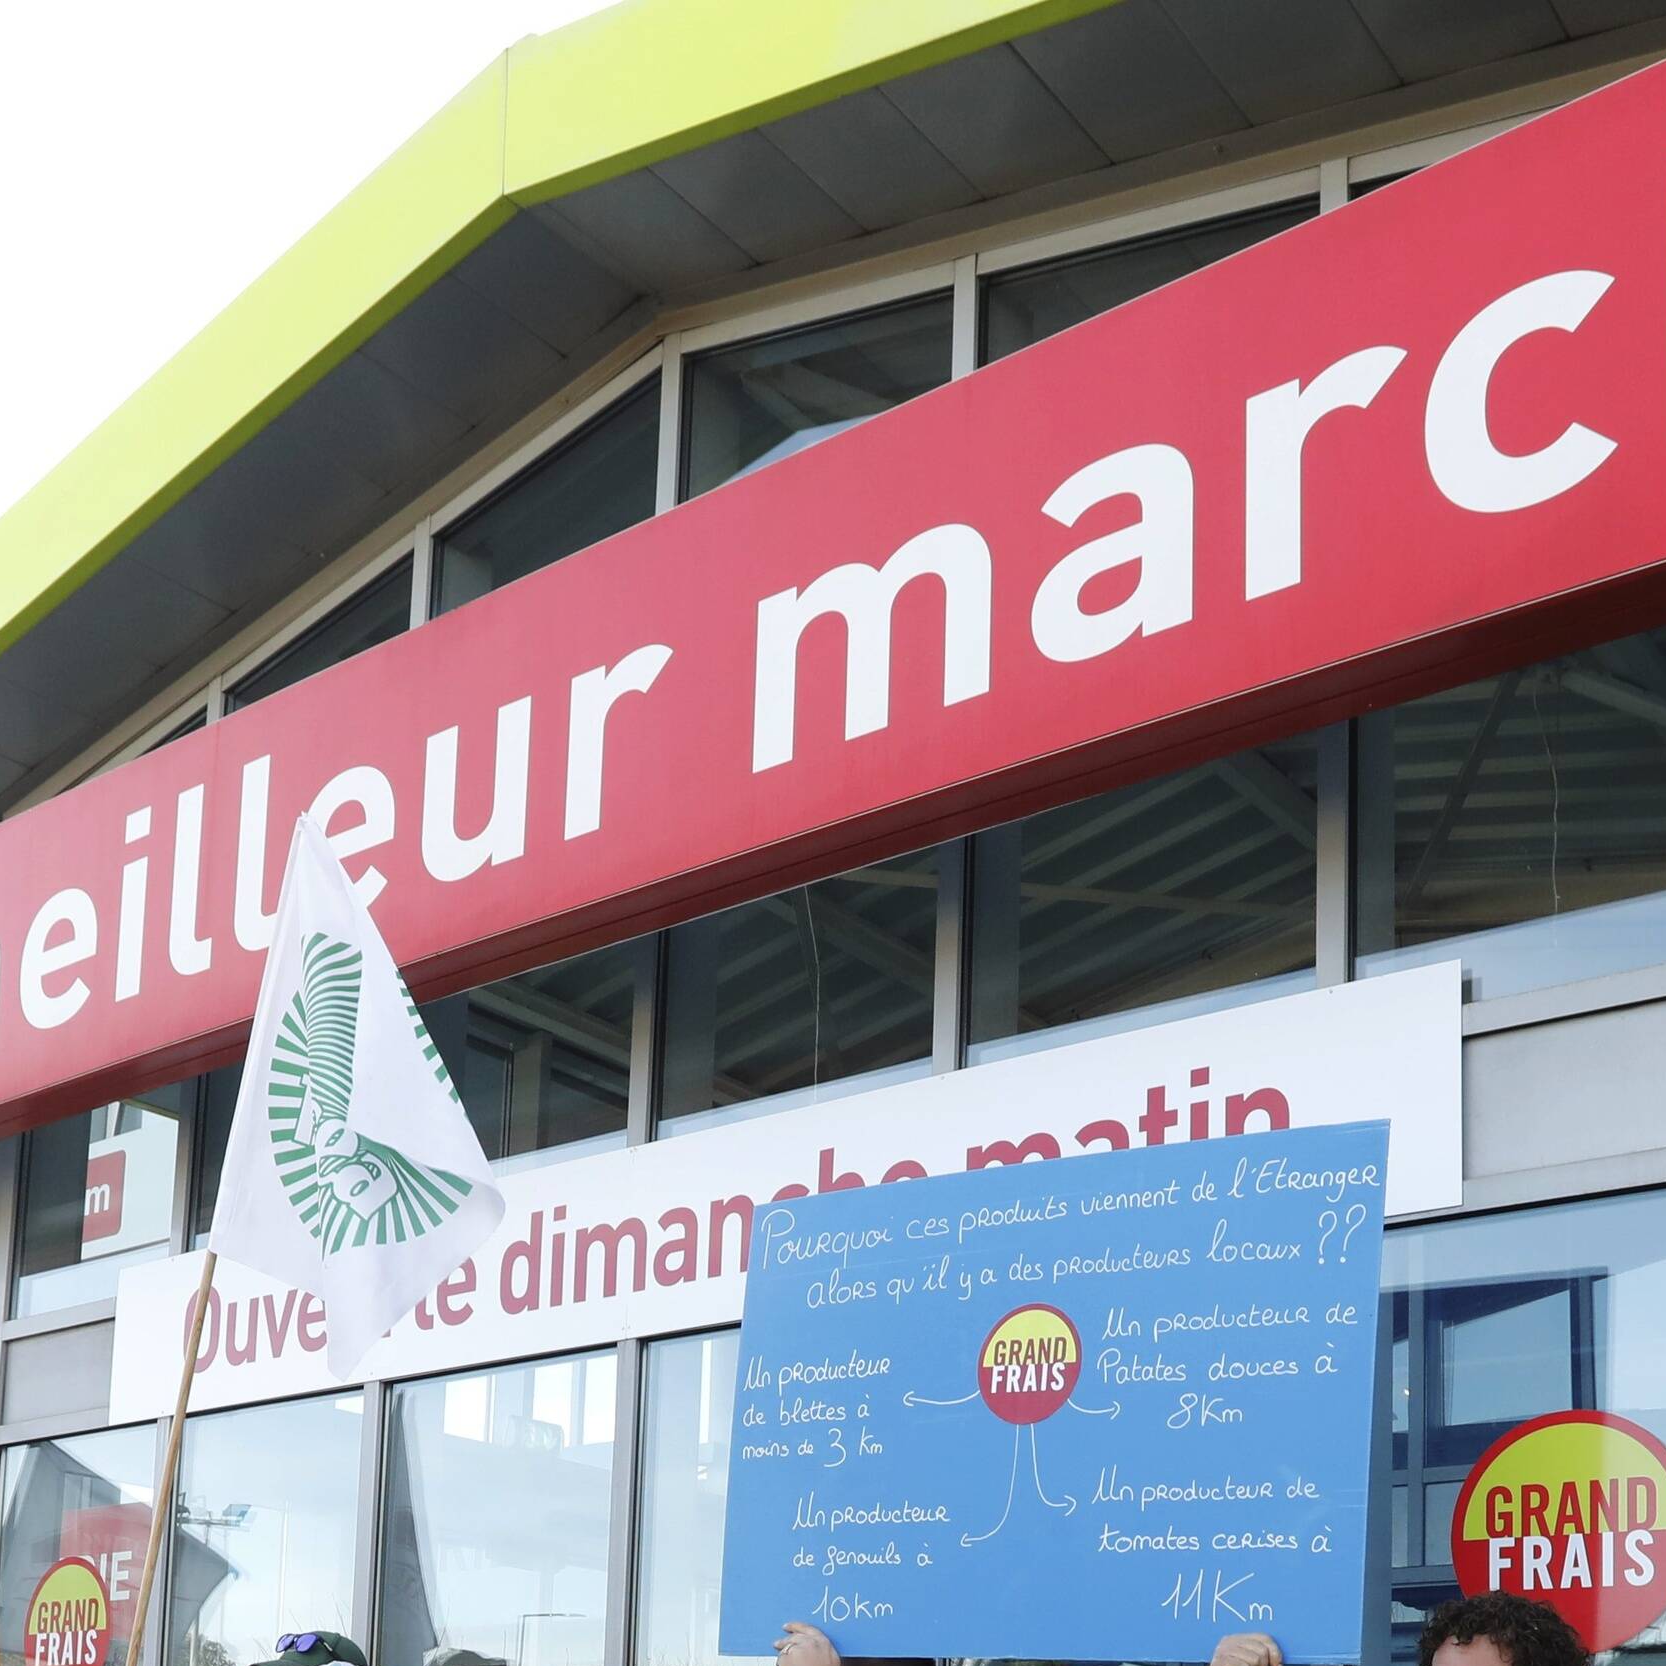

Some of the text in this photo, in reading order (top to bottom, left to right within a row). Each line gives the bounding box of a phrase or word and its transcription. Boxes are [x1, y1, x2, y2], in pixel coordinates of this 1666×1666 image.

[761, 1207, 894, 1270] Pourquoi
[906, 1216, 950, 1239] ces
[958, 1196, 1068, 1244] produits
[1081, 1179, 1181, 1216] viennent
[1191, 1170, 1218, 1202] de
[958, 1264, 972, 1301] y
[980, 1268, 998, 1286] a
[1008, 1254, 1044, 1282] des
[1053, 1244, 1191, 1284] producteurs
[1206, 1218, 1301, 1263] locaux
[1318, 1203, 1367, 1265] ??
[1101, 1302, 1358, 1343] Un producteur de
[993, 1336, 1068, 1367] GRAND
[1096, 1342, 1339, 1384] Patates douces à
[744, 1349, 891, 1396] Un producteur
[990, 1361, 1066, 1394] FRAIS
[743, 1394, 870, 1427] de blettes à
[742, 1440, 790, 1460] moins
[797, 1439, 814, 1455] de
[822, 1427, 847, 1467] 3
[1092, 1464, 1320, 1512] Un producteur de
[1484, 1475, 1658, 1540] GRAND
[792, 1491, 951, 1533] Un producteur
[793, 1548, 815, 1568] de
[916, 1543, 934, 1567] à
[1097, 1523, 1332, 1553] tomates cerises à
[1487, 1528, 1656, 1592] FRAIS
[37, 1597, 100, 1634] GRAND
